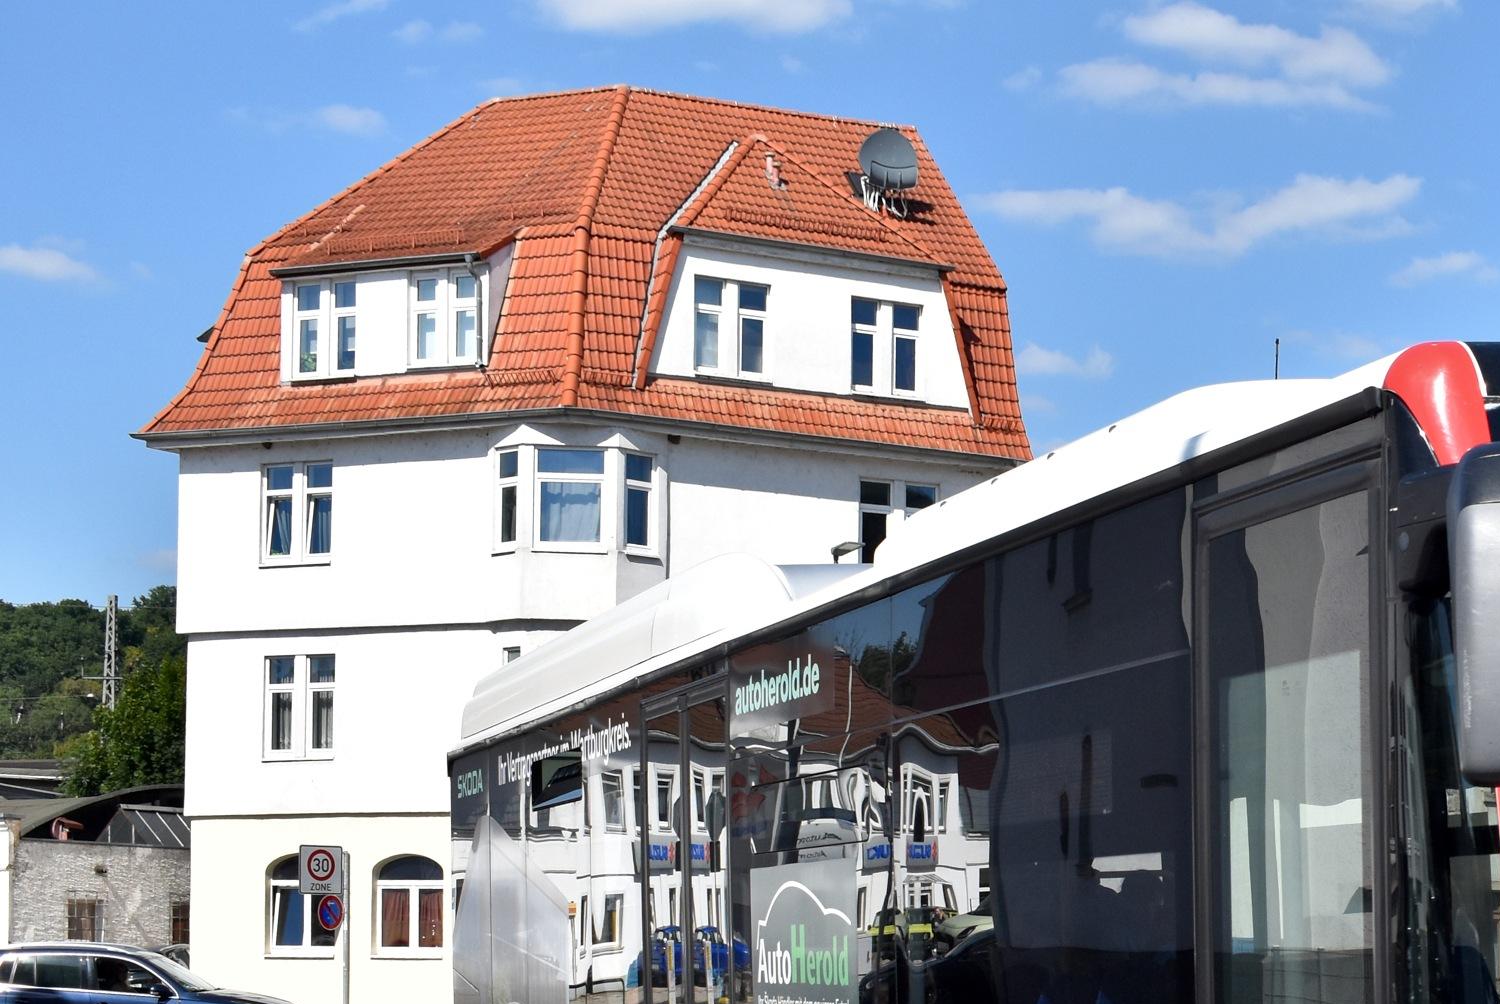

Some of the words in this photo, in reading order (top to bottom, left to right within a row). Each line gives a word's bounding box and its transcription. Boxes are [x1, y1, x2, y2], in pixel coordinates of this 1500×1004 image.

[735, 653, 820, 716] autoherold.de
[498, 755, 507, 786] Ihr
[312, 857, 330, 873] 30
[310, 882, 332, 891] ZONE
